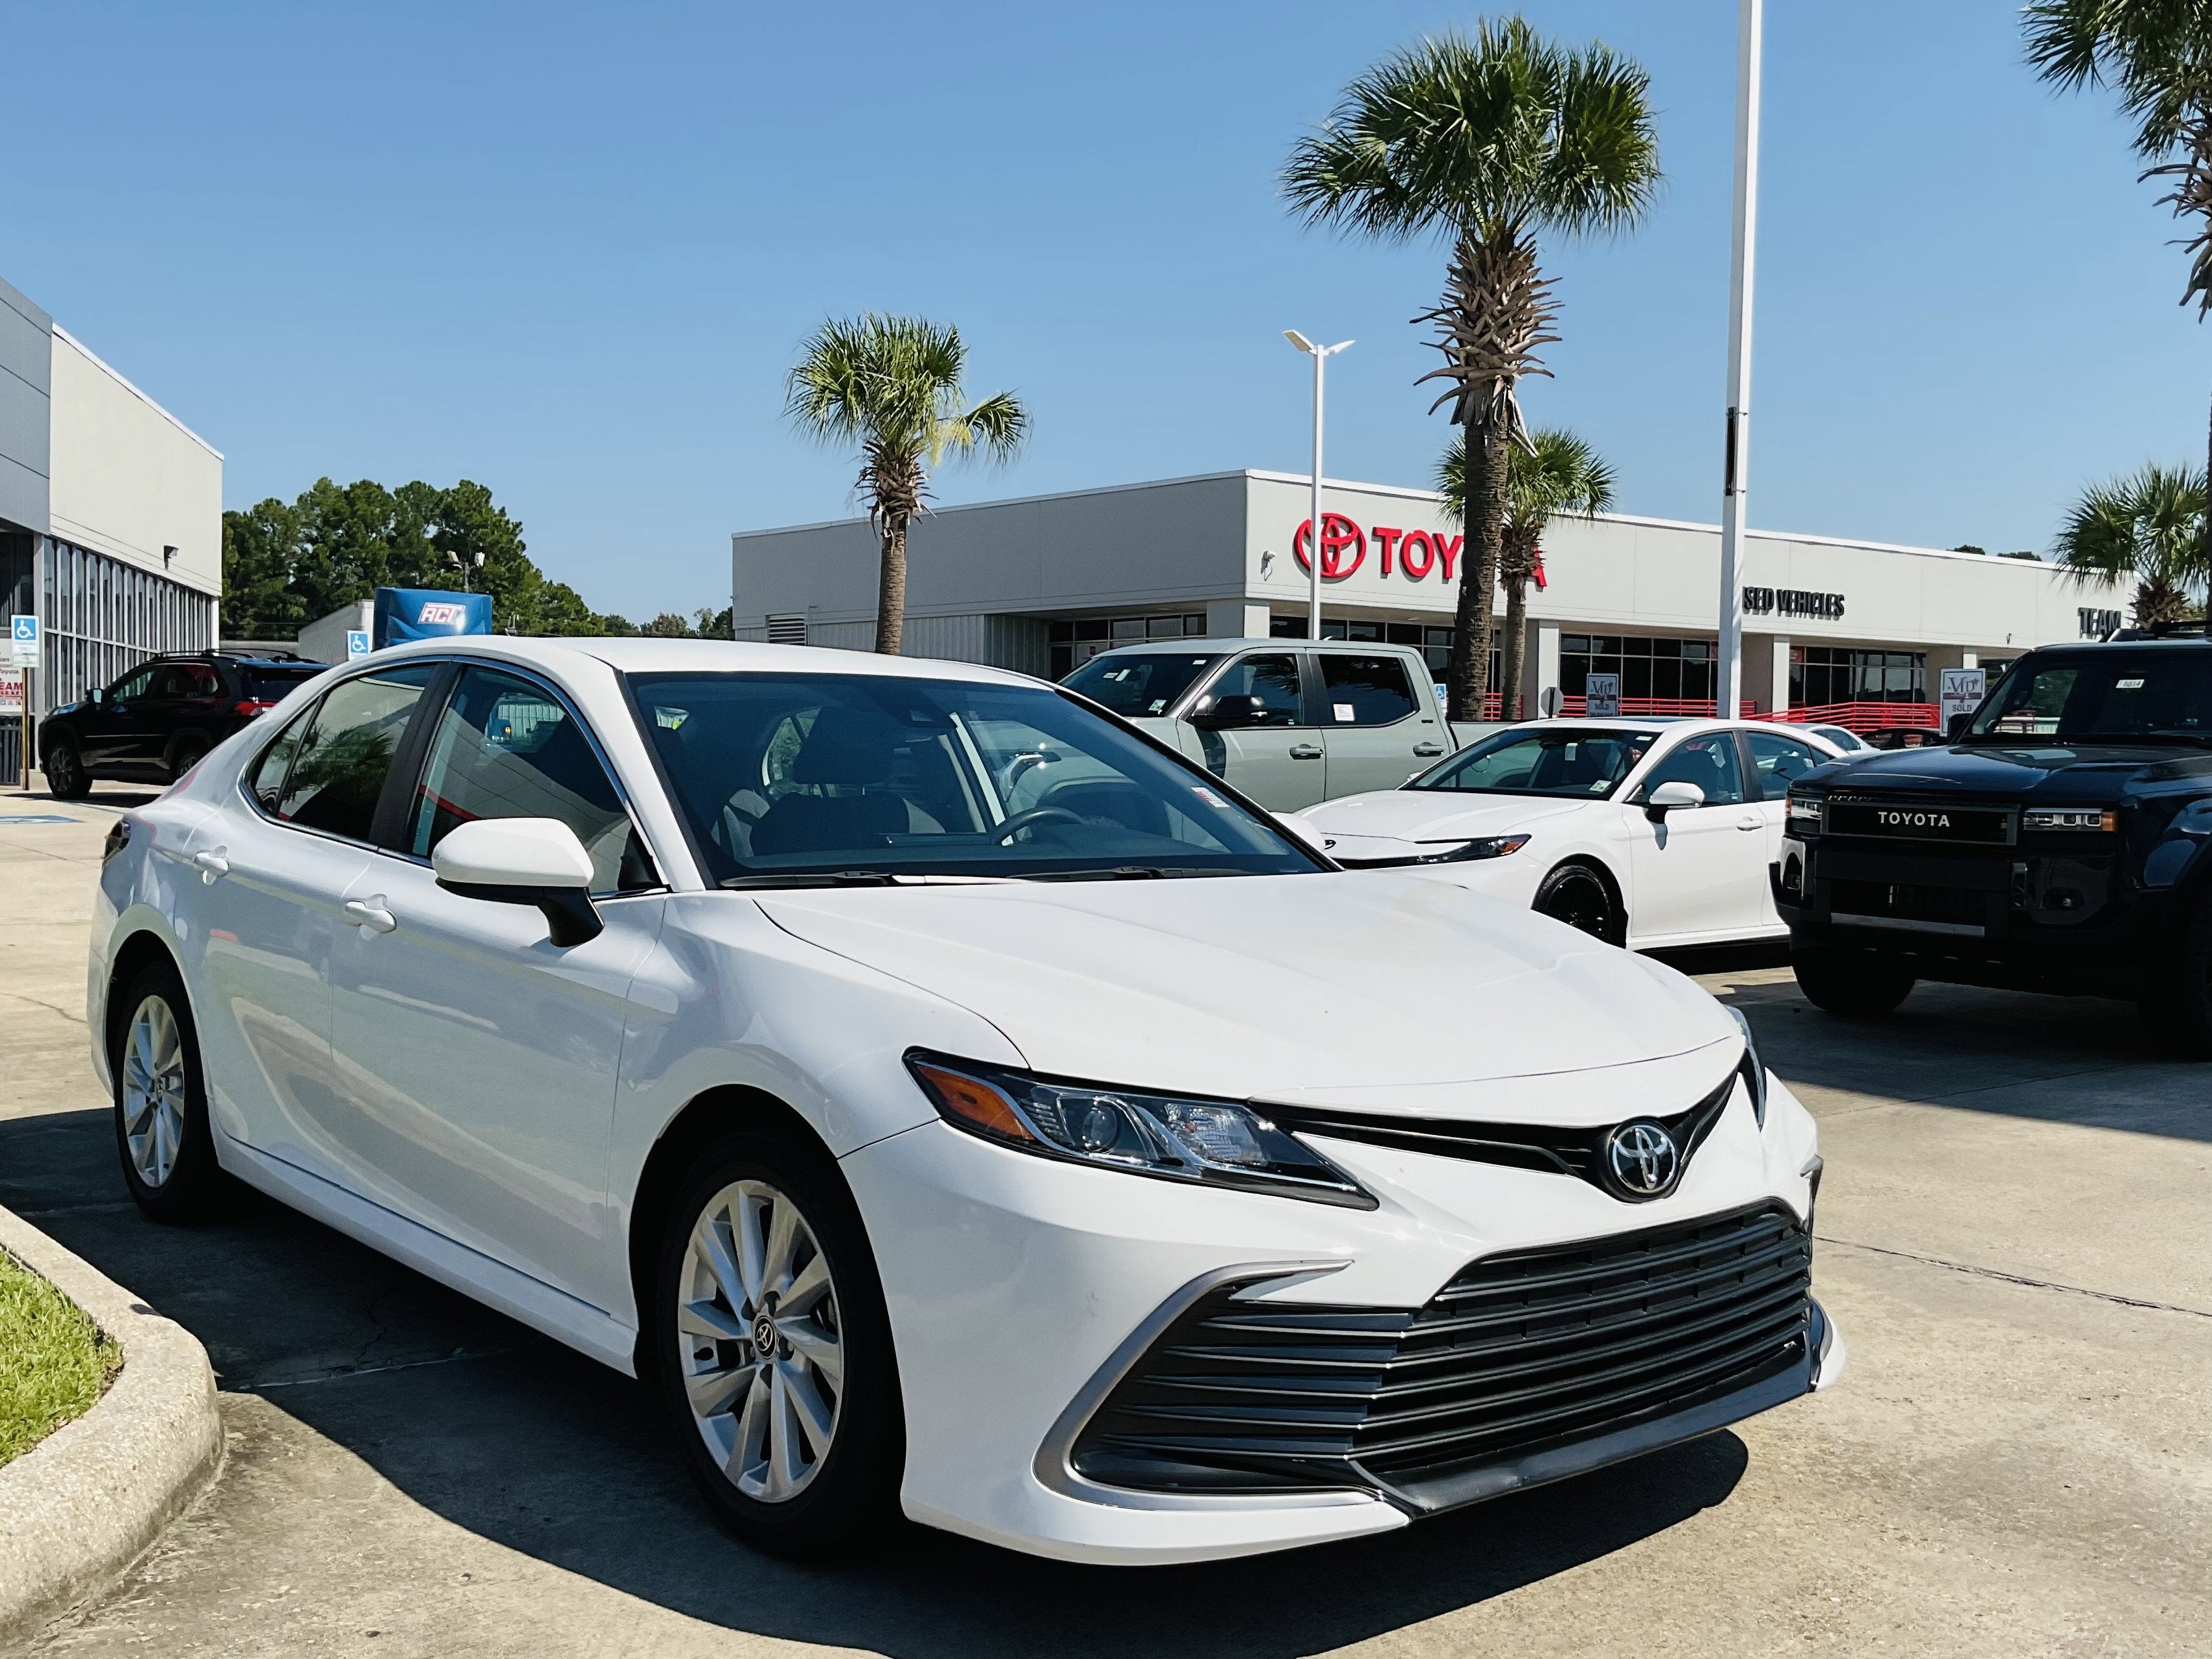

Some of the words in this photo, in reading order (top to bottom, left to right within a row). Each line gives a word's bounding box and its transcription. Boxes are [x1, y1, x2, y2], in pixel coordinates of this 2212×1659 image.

[1373, 527, 1547, 587] TOY
[1776, 589, 1845, 617] VEHICLES
[2078, 607, 2122, 635] TEAM
[0, 682, 23, 690] EAM
[1878, 811, 1950, 827] TOYOTA
